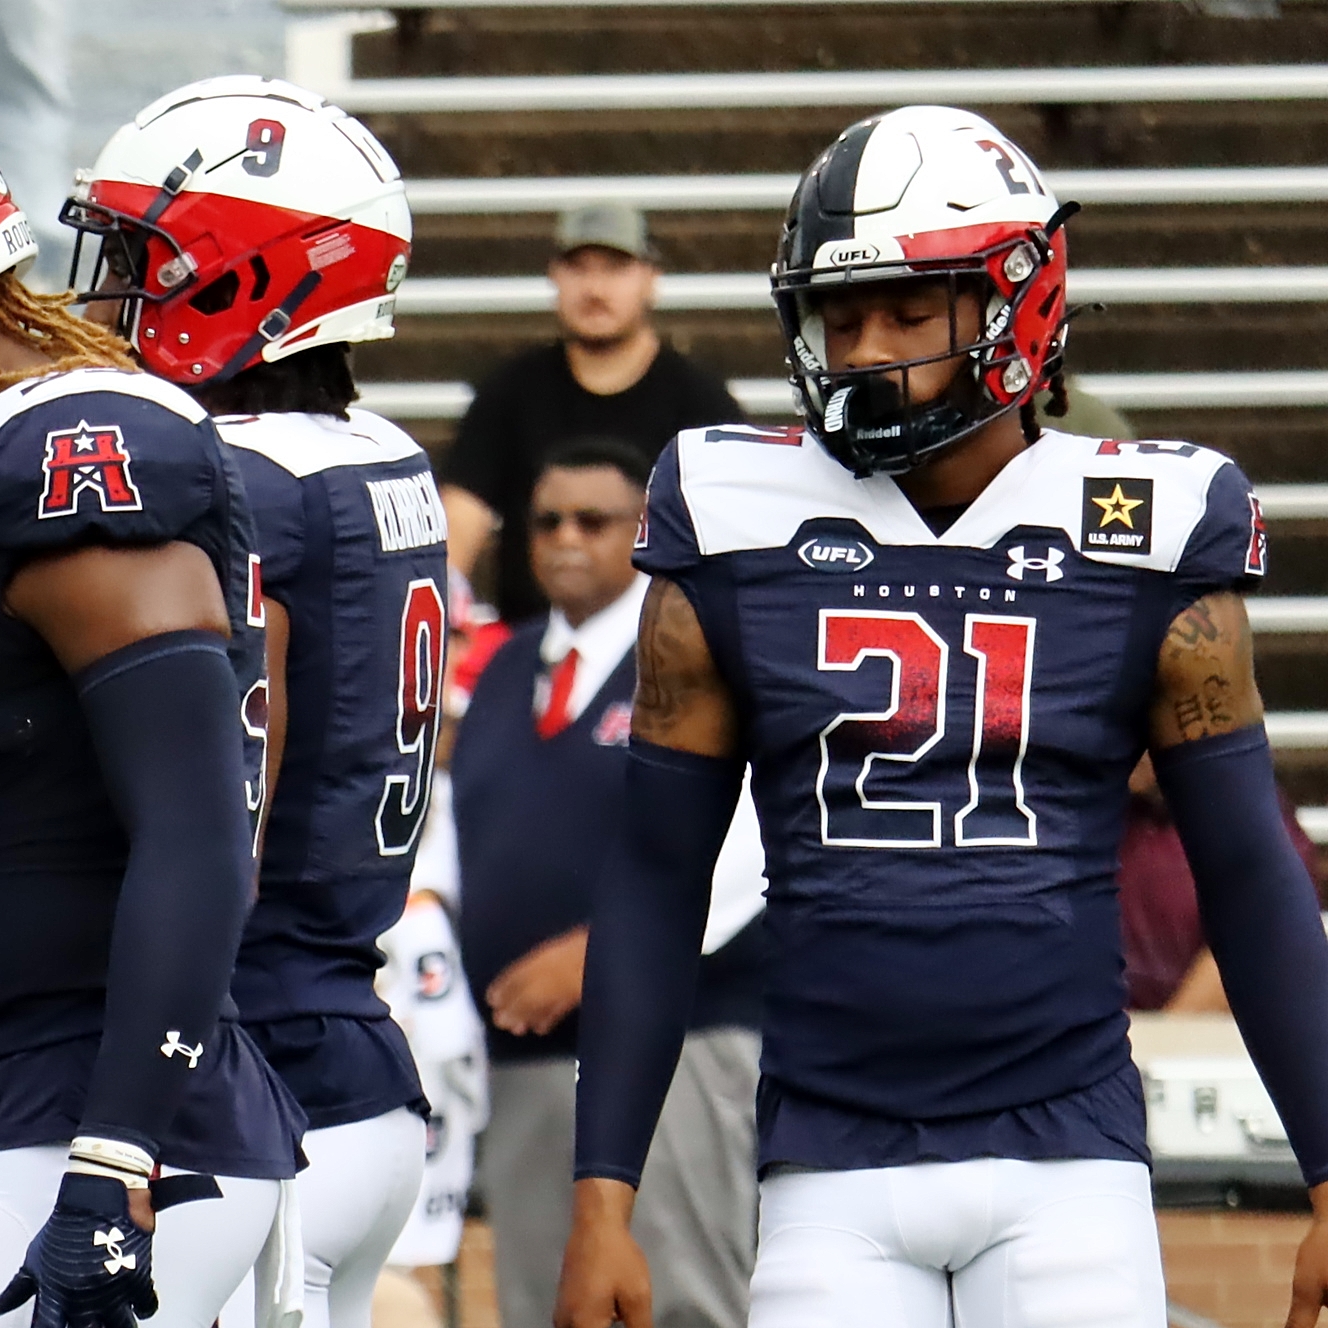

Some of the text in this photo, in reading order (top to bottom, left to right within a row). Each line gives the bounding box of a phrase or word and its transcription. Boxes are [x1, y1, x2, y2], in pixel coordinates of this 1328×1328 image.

[241, 118, 286, 178] 9
[838, 250, 872, 262] UFL
[856, 425, 901, 440] Riddell
[1088, 532, 1144, 547] U.S. ARMY
[811, 545, 862, 563] UFL
[852, 583, 1016, 603] HOUSTON
[375, 577, 445, 857] 9
[815, 608, 1039, 849] 21
